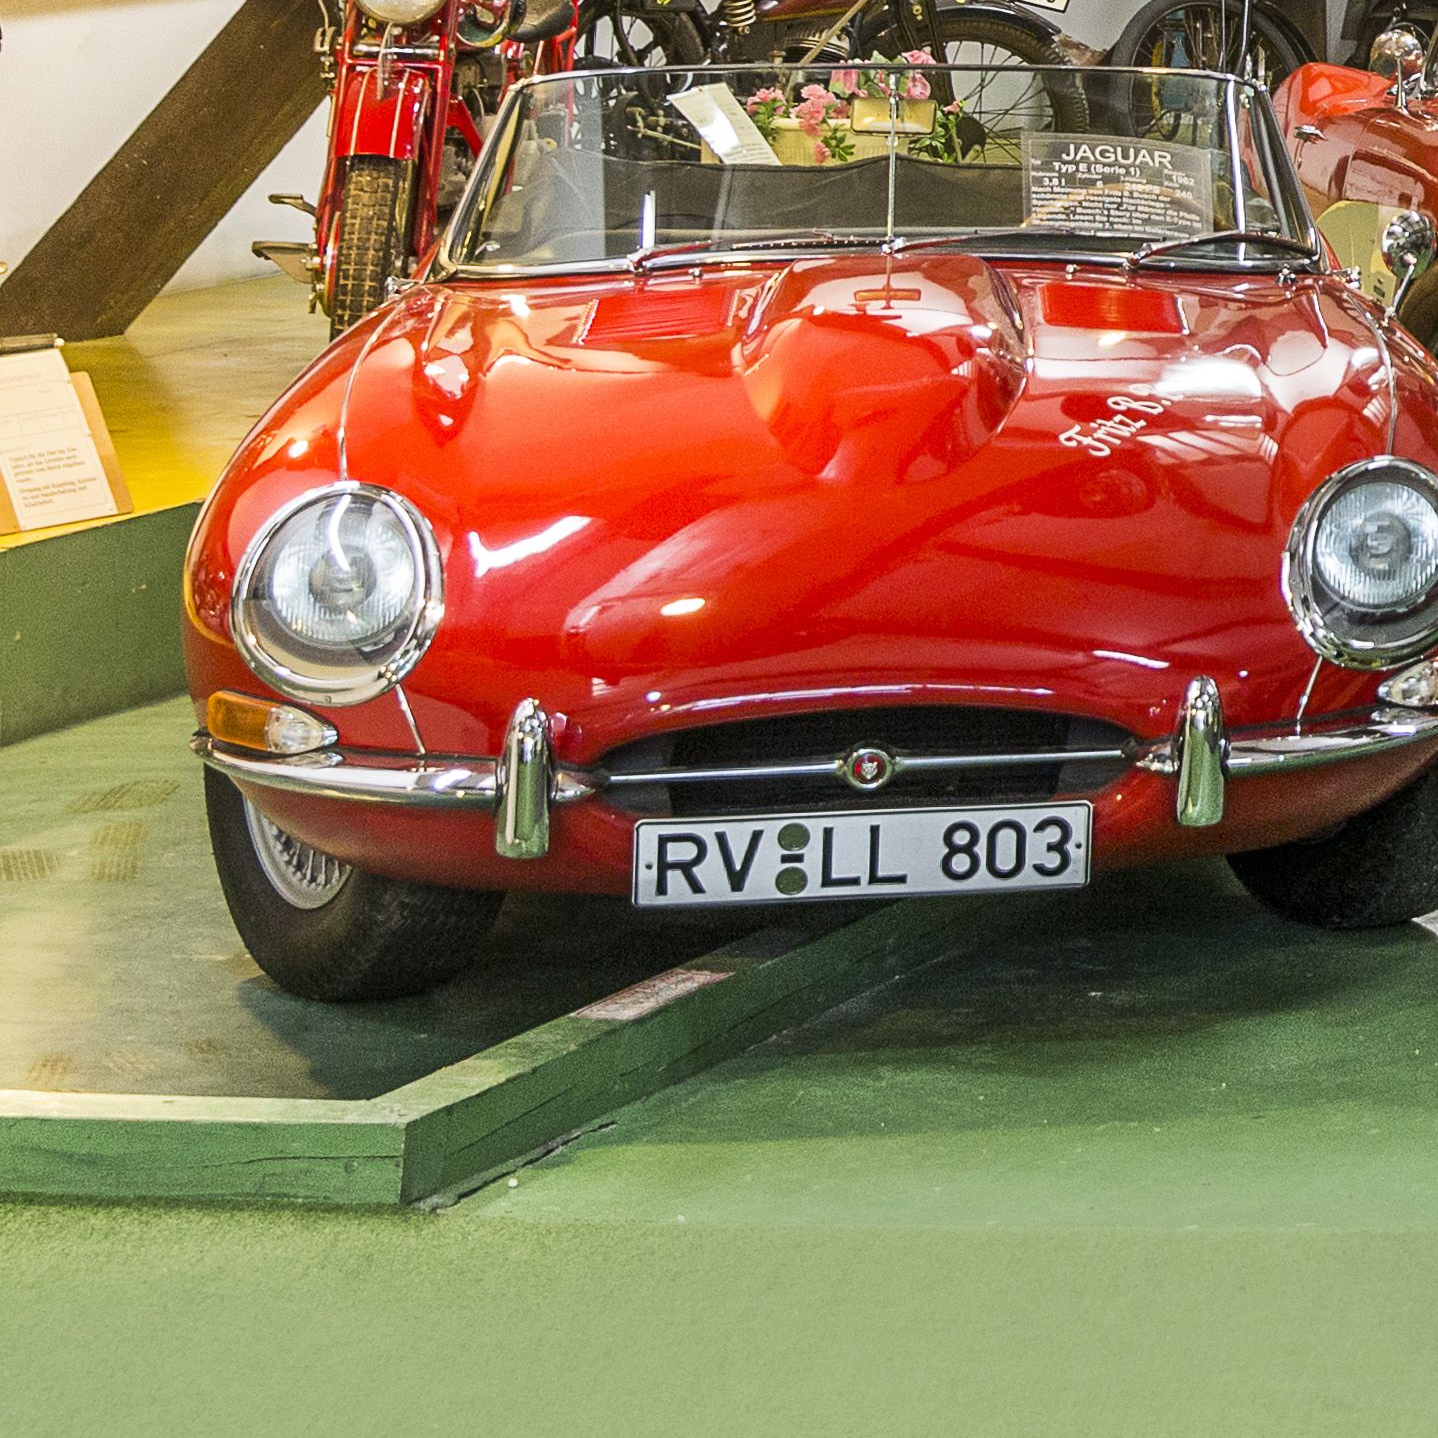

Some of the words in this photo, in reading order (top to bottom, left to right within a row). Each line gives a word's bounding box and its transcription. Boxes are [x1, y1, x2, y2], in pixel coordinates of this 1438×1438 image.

[1052, 161, 1077, 174] Typ
[1079, 162, 1089, 173] E
[1090, 163, 1127, 175] (Serie
[1062, 143, 1173, 170] JAGUAR
[939, 815, 1073, 882] 803
